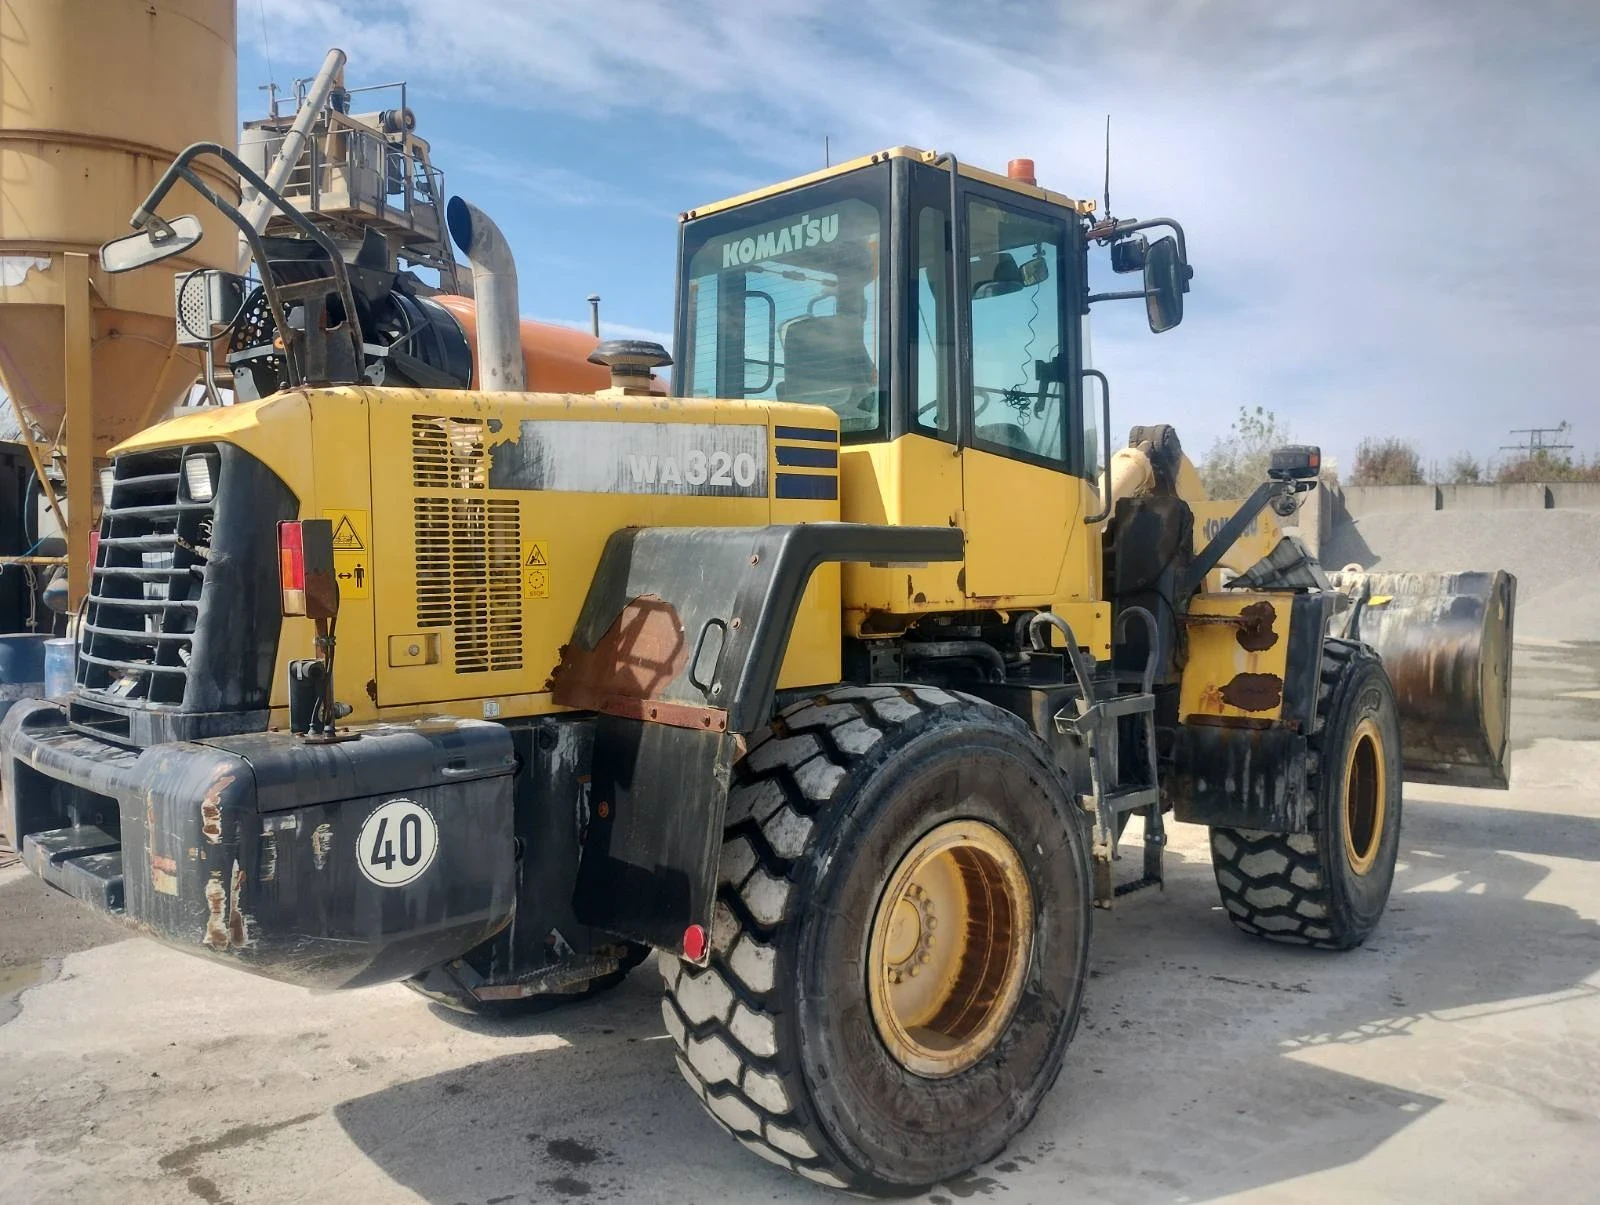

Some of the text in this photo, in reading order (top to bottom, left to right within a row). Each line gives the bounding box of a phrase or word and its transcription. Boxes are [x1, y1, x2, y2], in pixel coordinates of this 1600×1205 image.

[722, 213, 839, 269] KOMATSU
[626, 450, 756, 487] WA320
[371, 813, 422, 870] 40
